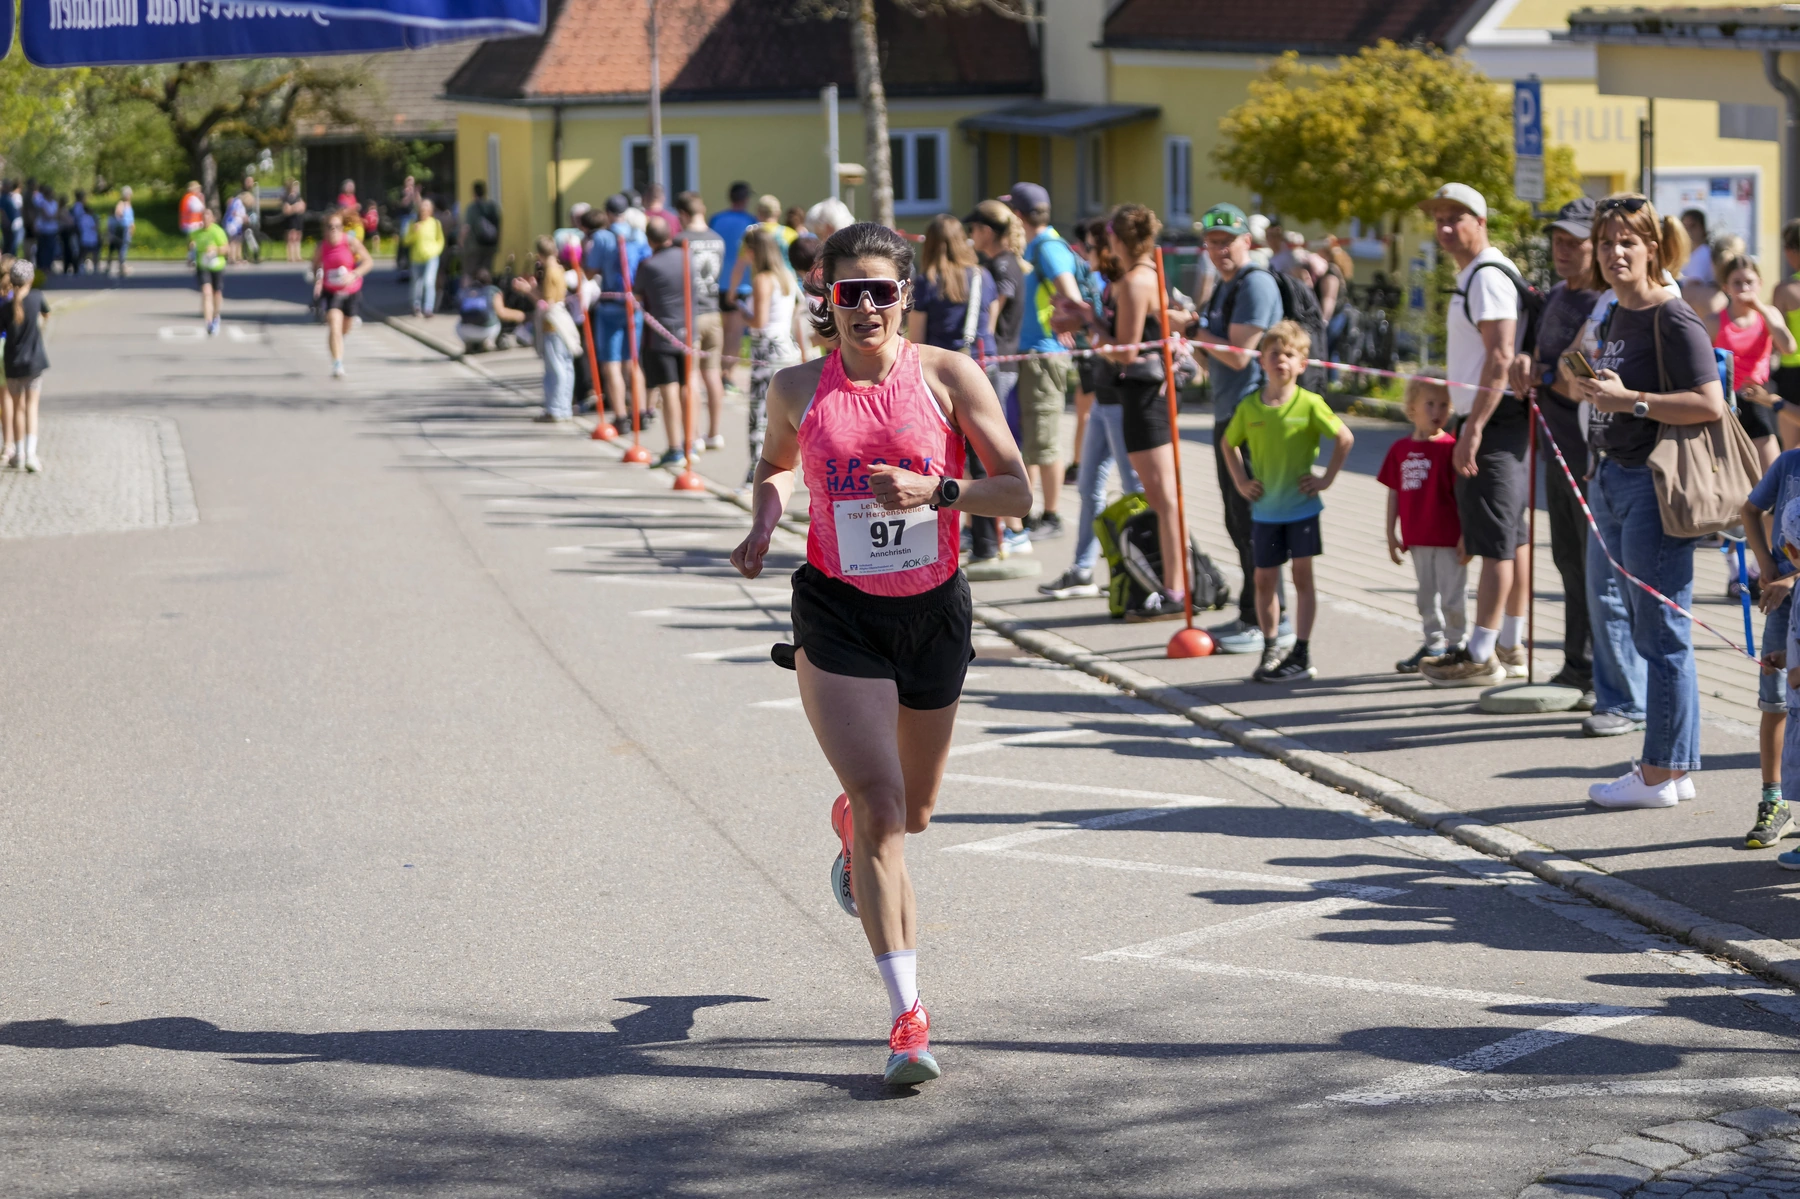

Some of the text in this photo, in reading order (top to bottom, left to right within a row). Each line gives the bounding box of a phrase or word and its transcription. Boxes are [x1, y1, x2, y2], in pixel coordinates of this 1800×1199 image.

[1604, 339, 1625, 356] DO
[847, 512, 863, 520] TSV
[870, 519, 906, 548] 97
[870, 548, 912, 559] Annchristin
[902, 558, 922, 569] AOK
